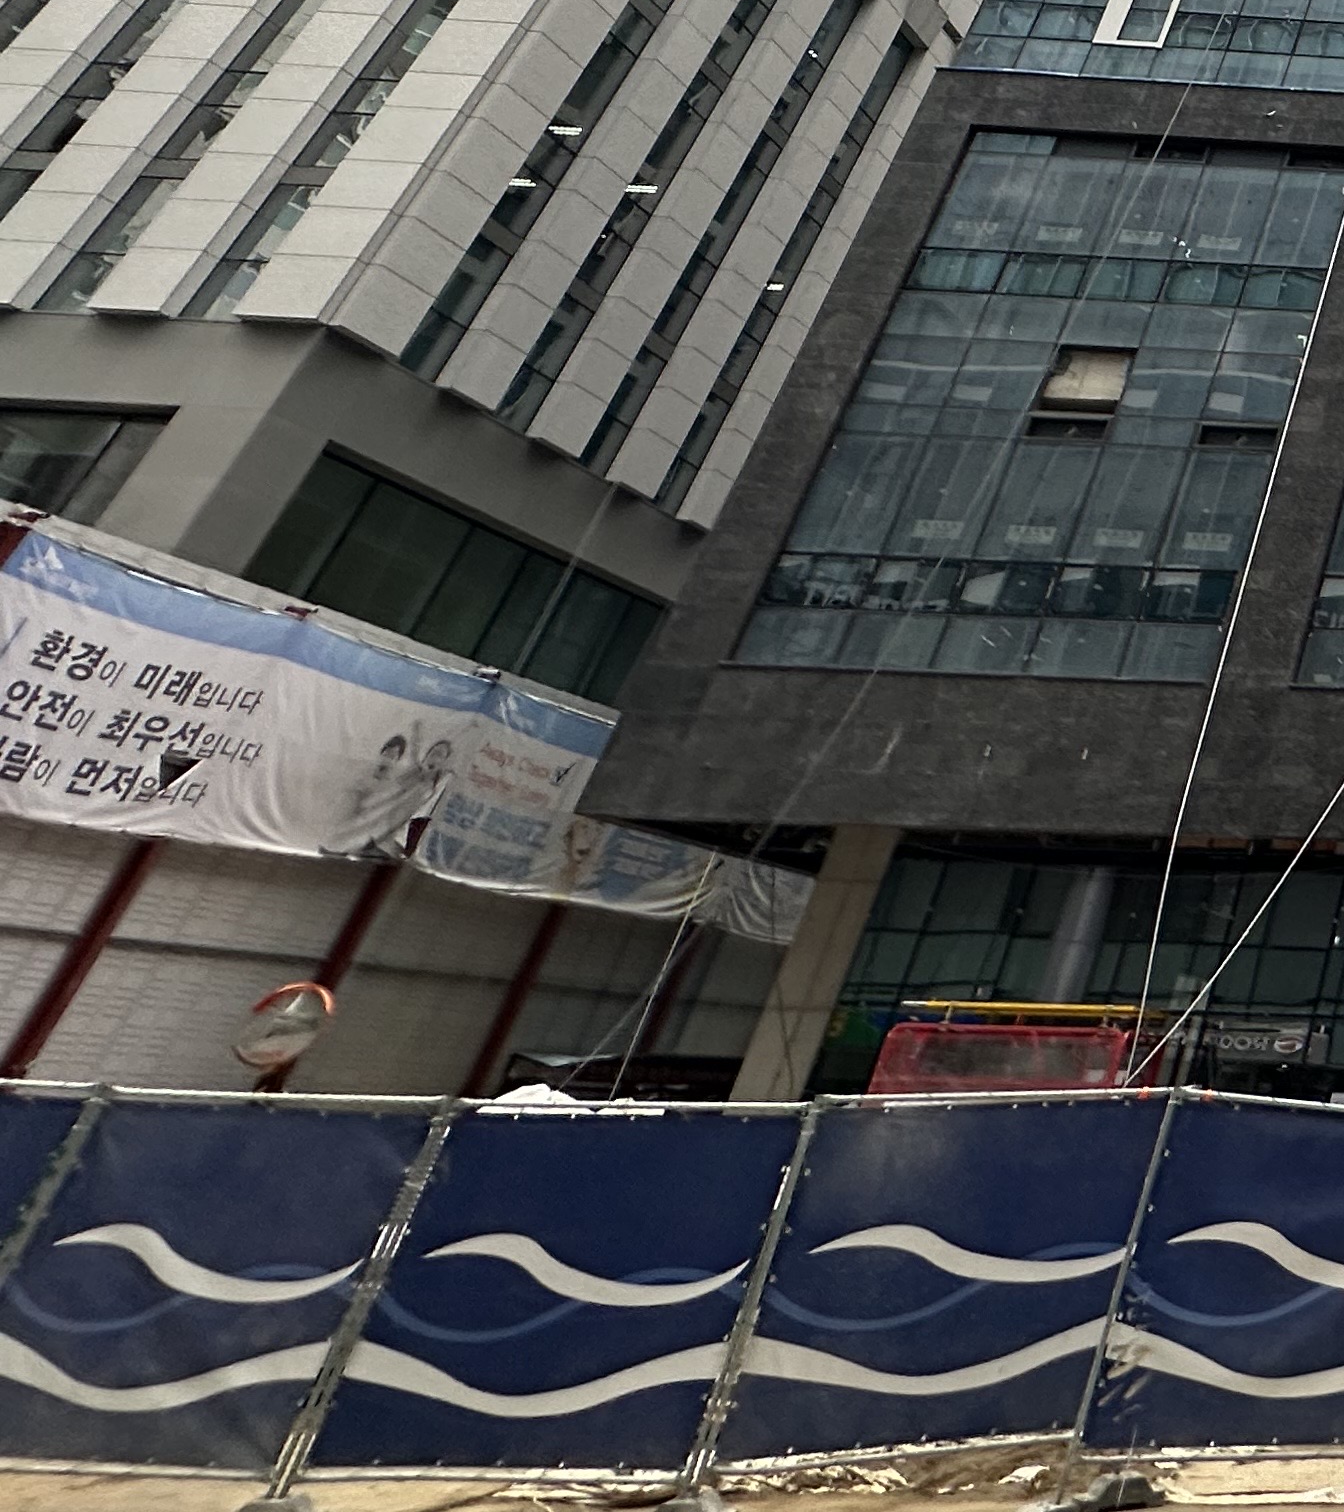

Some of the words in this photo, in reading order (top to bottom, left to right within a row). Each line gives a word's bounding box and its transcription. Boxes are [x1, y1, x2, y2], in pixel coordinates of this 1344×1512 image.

[31, 629, 127, 688] 환경이
[133, 663, 264, 715] 미래입니다
[0, 679, 95, 737] 안전이
[98, 708, 263, 768] 최우선입니다
[66, 756, 208, 808] 먼저입니다
